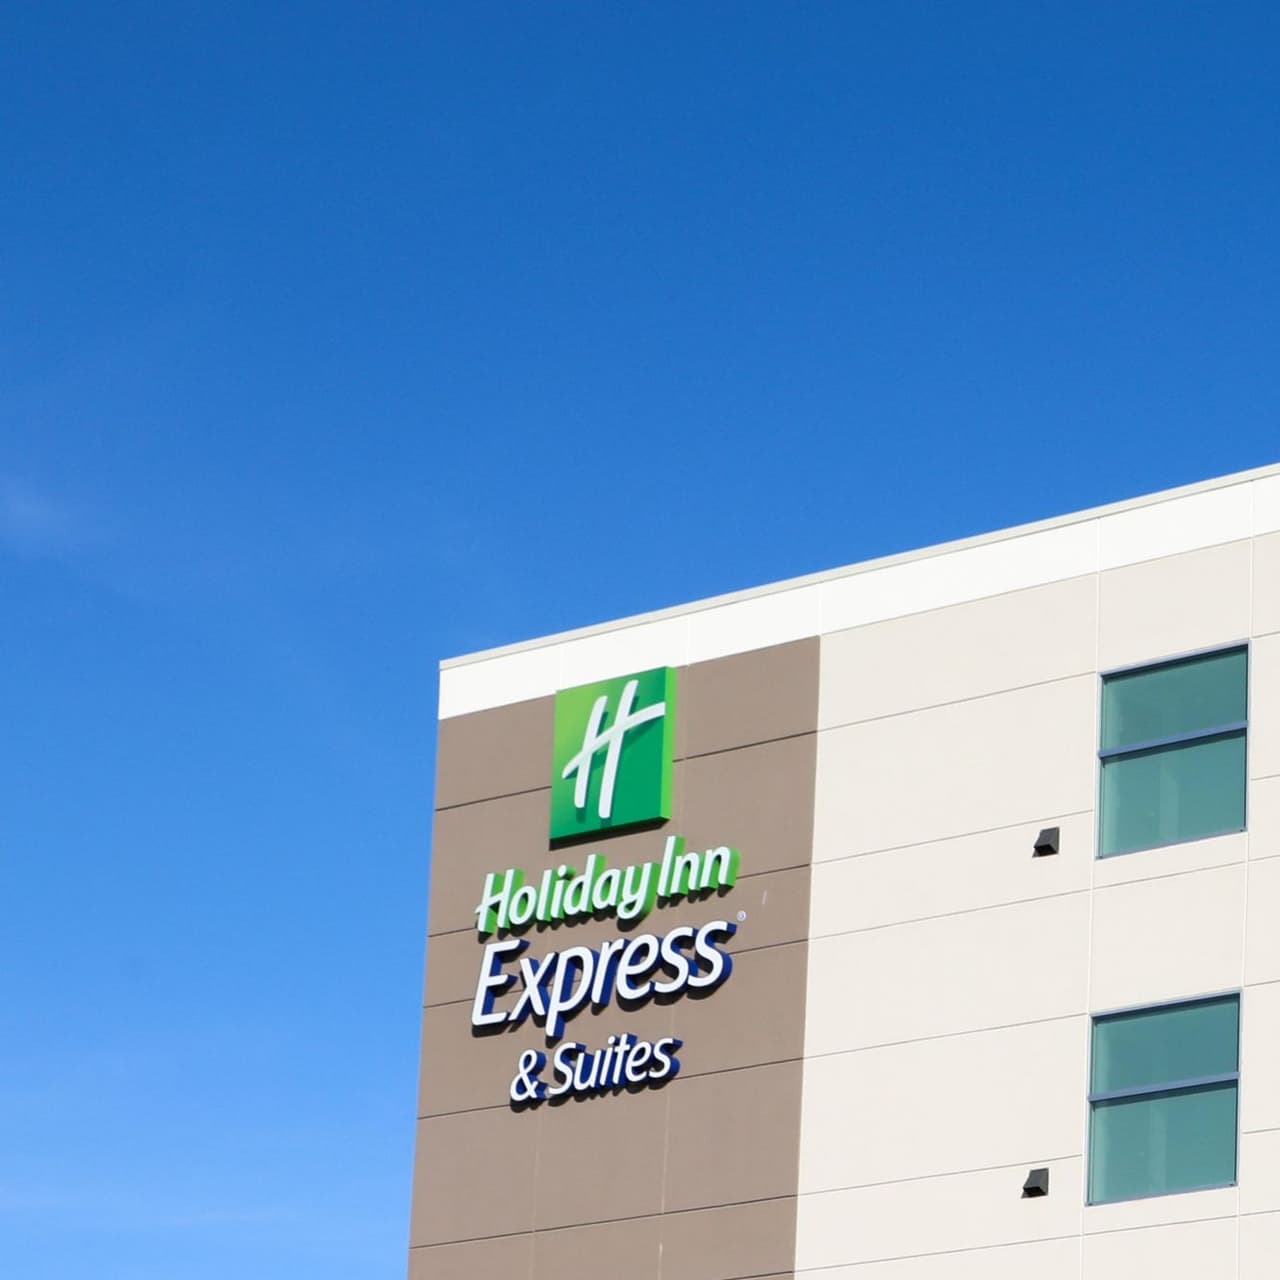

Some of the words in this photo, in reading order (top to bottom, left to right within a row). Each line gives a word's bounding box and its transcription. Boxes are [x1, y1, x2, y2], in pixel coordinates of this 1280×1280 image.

[475, 852, 660, 933] Holiday
[656, 835, 739, 897] Inn
[471, 919, 737, 1037] Express
[510, 1049, 549, 1101] &
[547, 1032, 682, 1096] Suites
